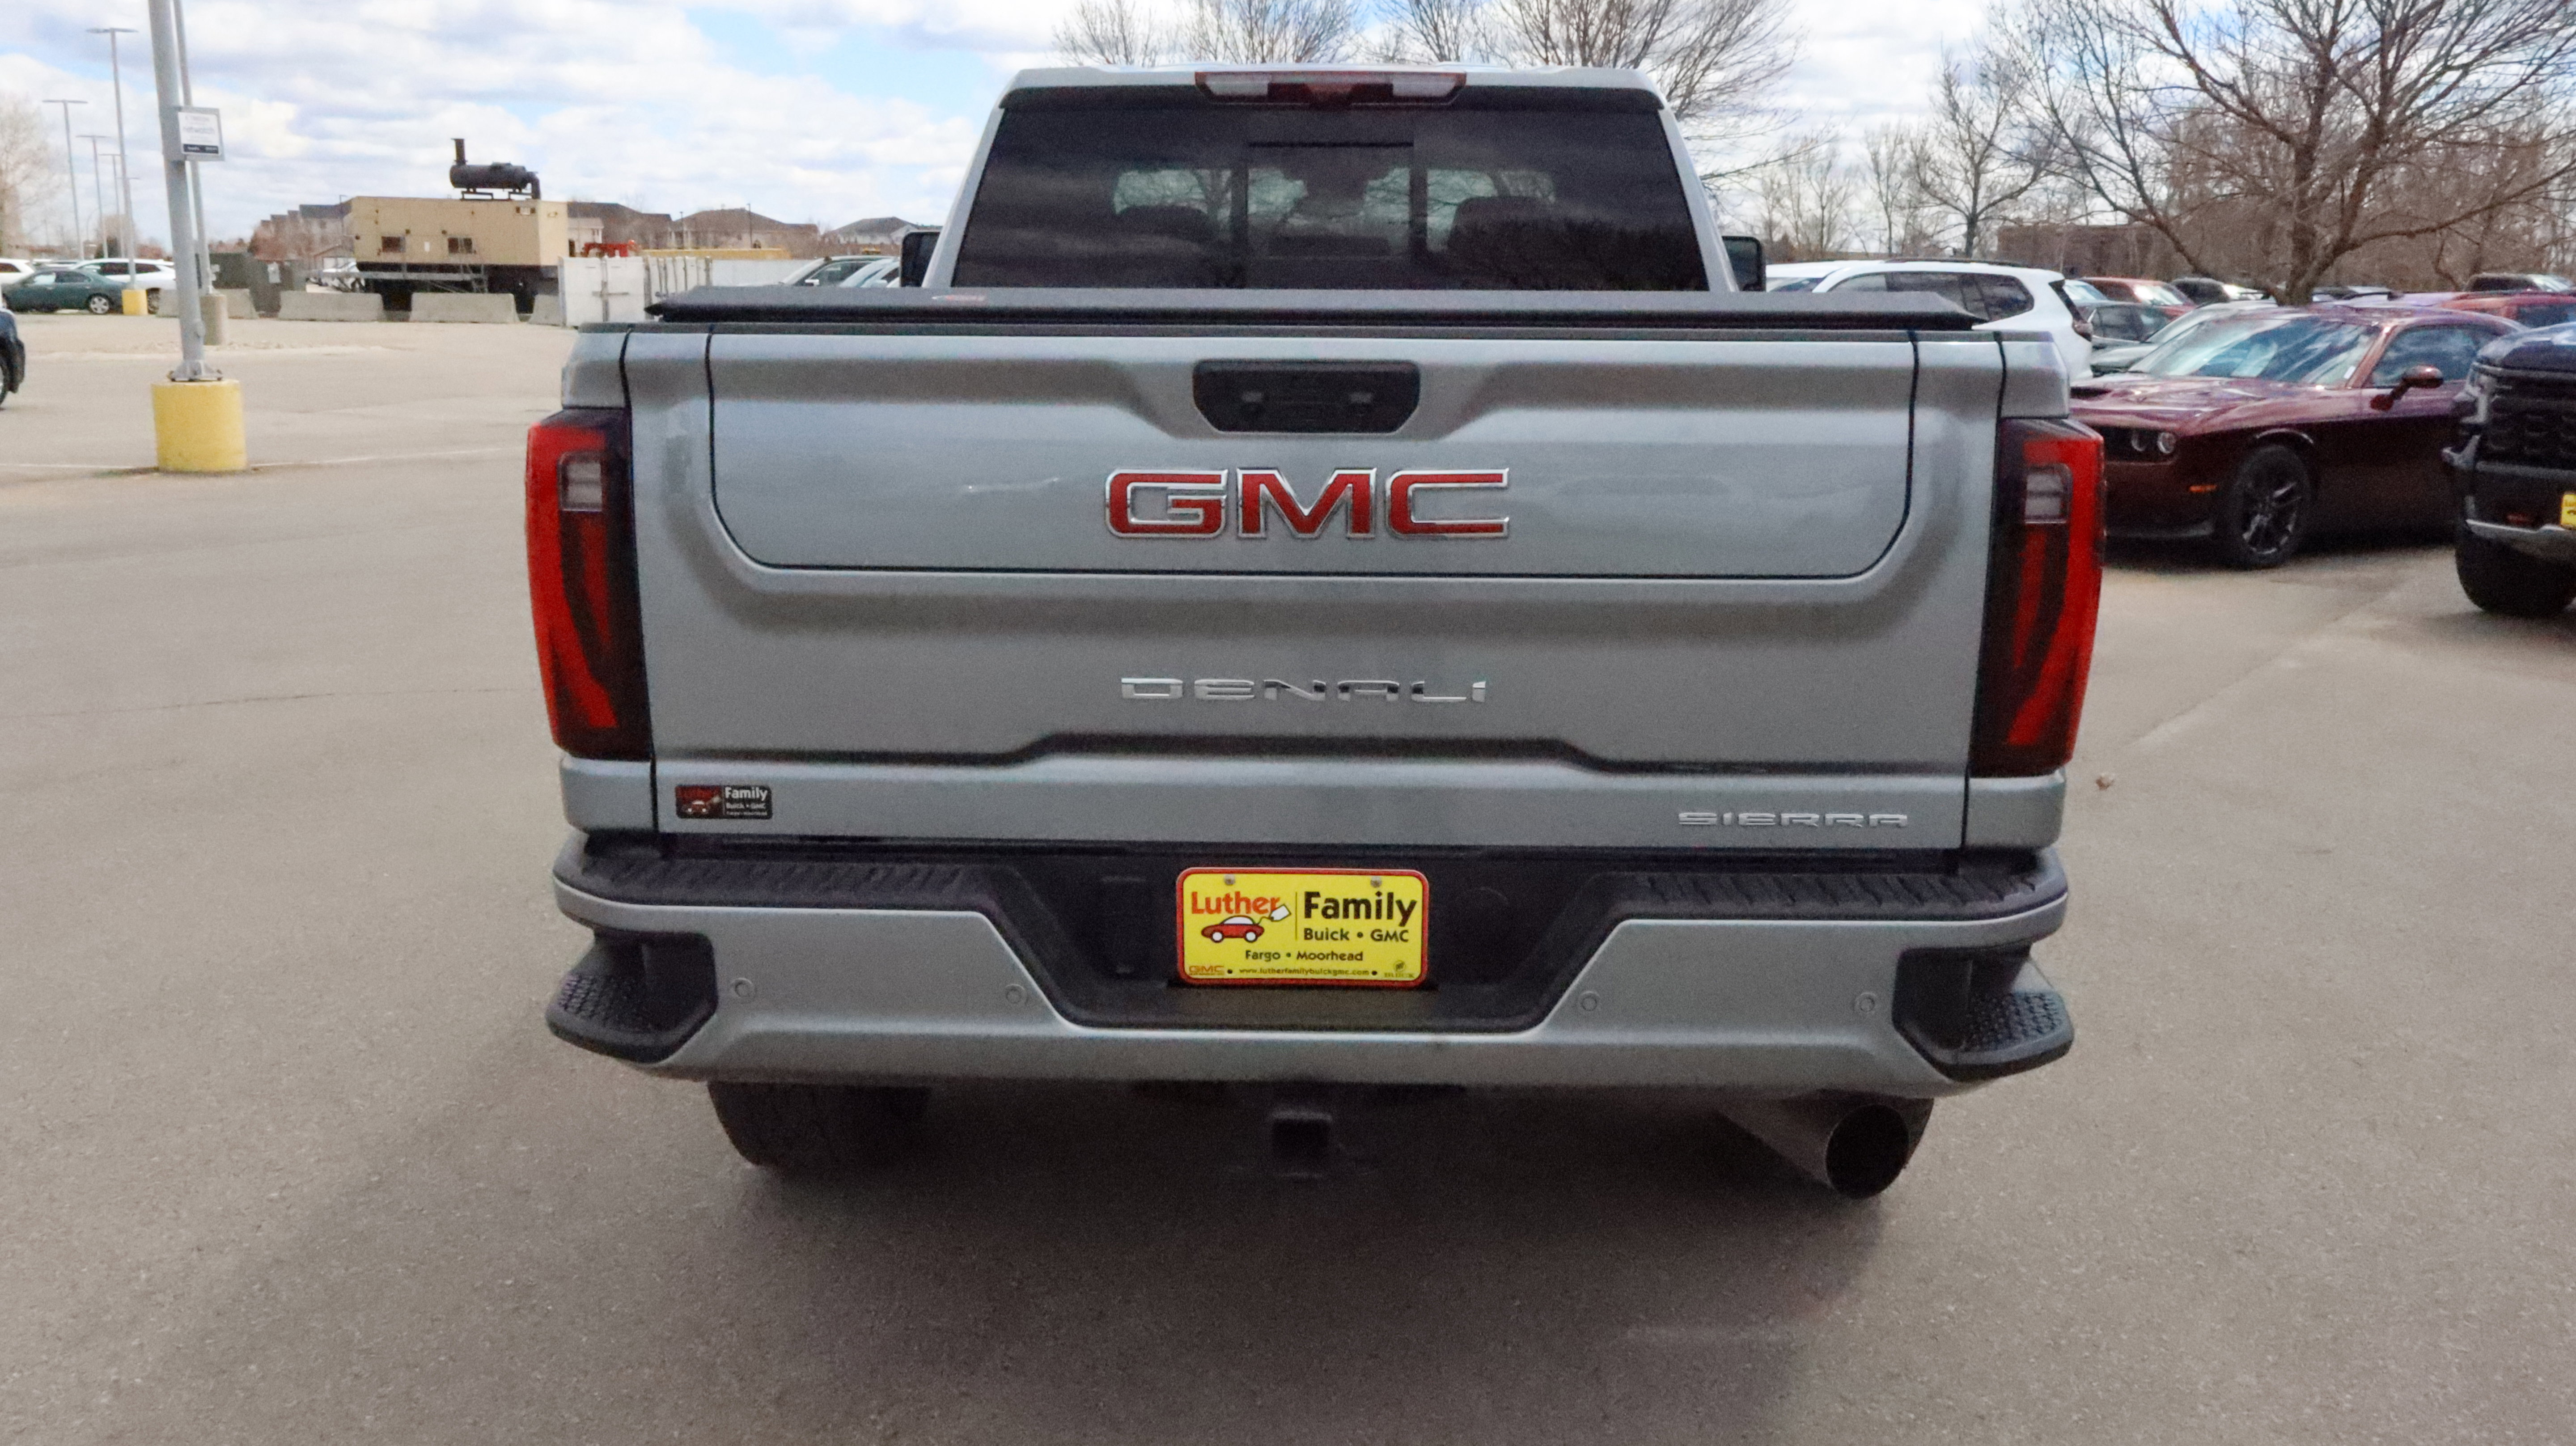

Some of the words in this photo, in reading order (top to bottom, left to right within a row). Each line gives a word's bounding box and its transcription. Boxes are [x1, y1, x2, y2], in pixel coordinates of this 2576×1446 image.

[1104, 467, 1509, 538] GMC
[1121, 678, 1486, 702] DENALI
[725, 787, 767, 801] Family
[1678, 812, 1908, 827] SIERRA
[1191, 891, 1280, 914] Luther
[1304, 891, 1417, 927] Family
[1304, 927, 1350, 941] Buick
[1370, 929, 1409, 942] GMC
[1246, 950, 1280, 962] Fargo
[1296, 950, 1363, 961] Moorhead
[1239, 967, 1369, 976] www.lutherfamilybuickgmc.com
